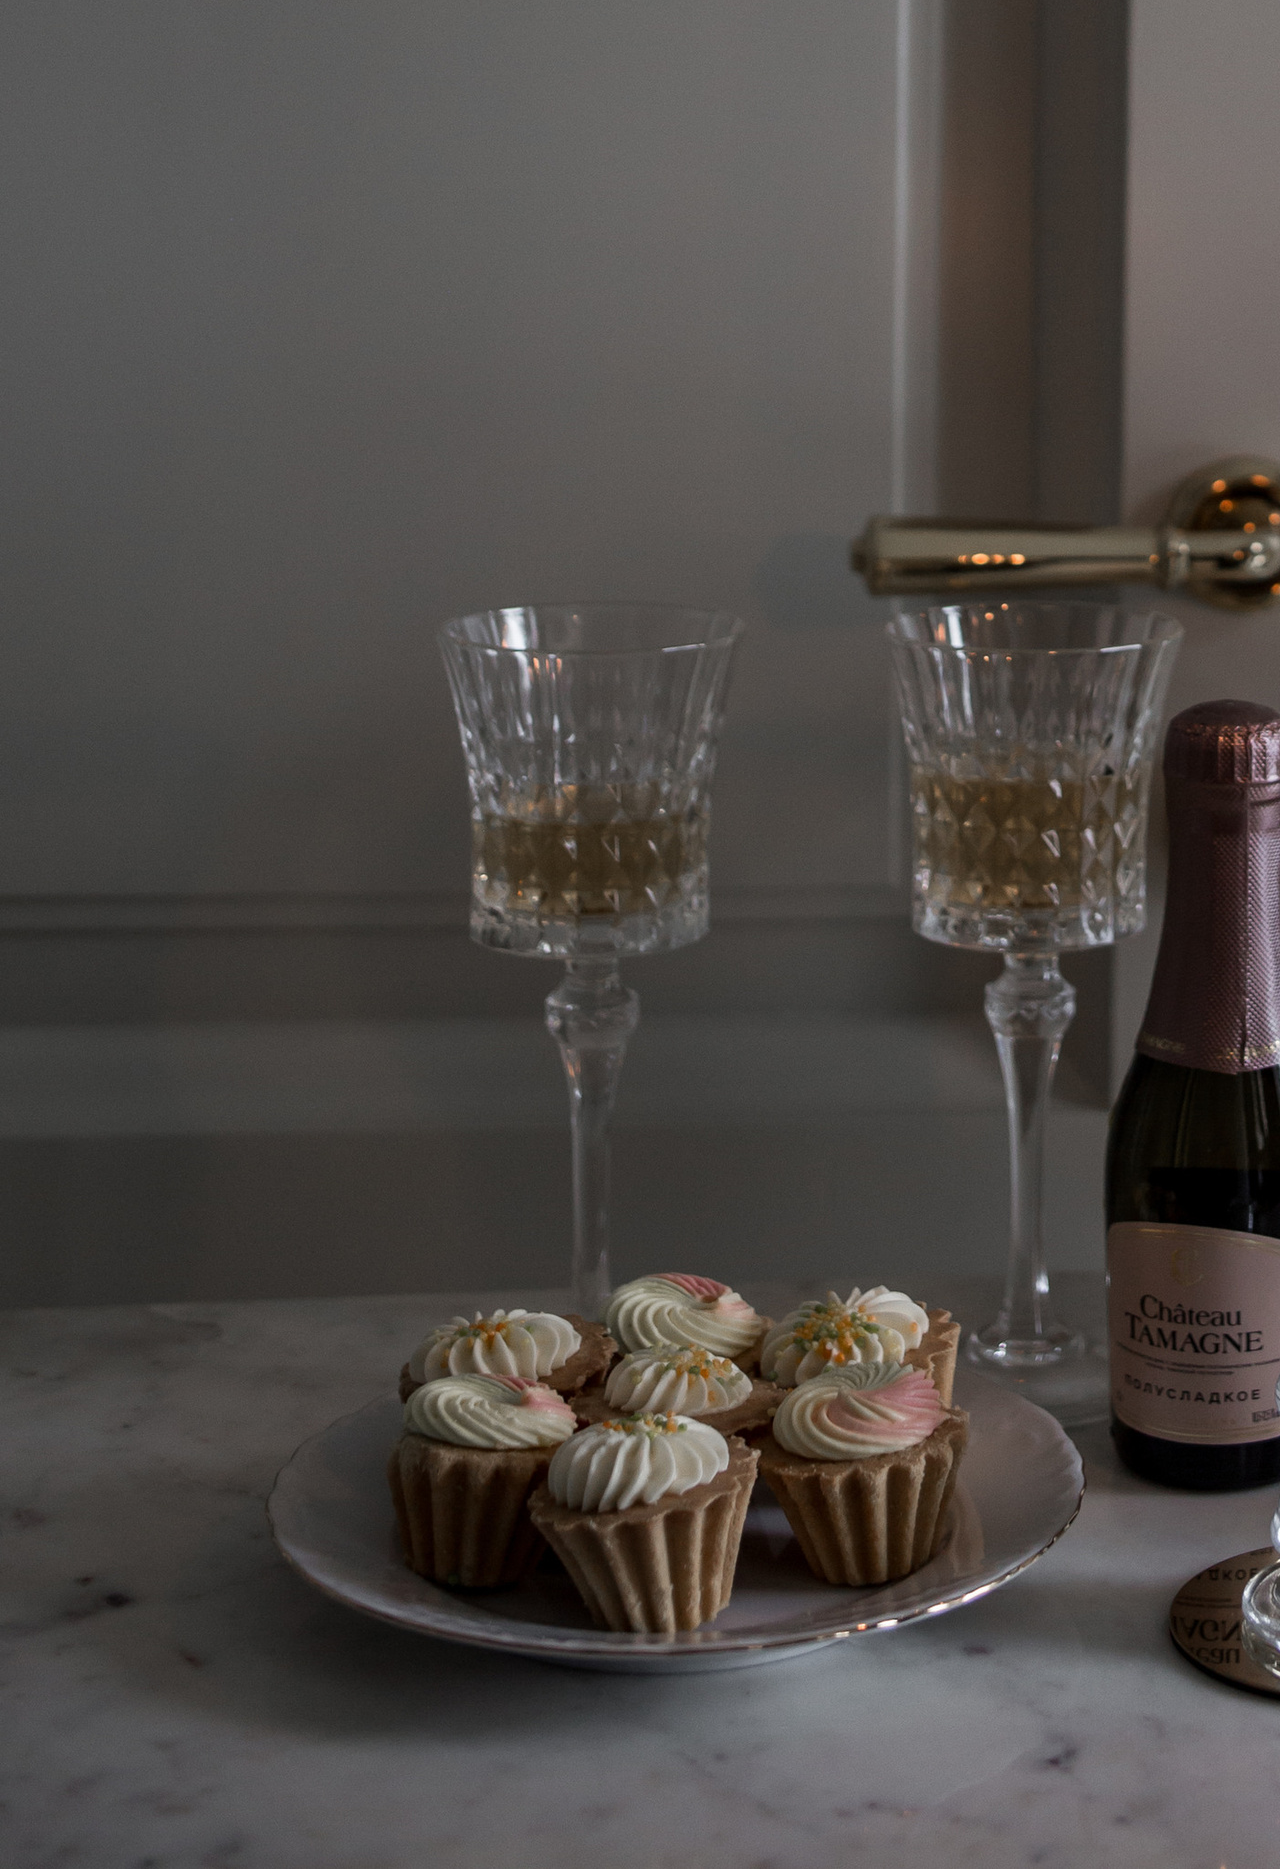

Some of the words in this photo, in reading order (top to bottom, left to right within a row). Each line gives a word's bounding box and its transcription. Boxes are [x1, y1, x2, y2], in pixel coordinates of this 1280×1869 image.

[1140, 1294, 1241, 1327] Château
[1124, 1312, 1264, 1355] TAMAGNE
[1124, 1373, 1262, 1405] ПОЛУСЛАДКОЕ
